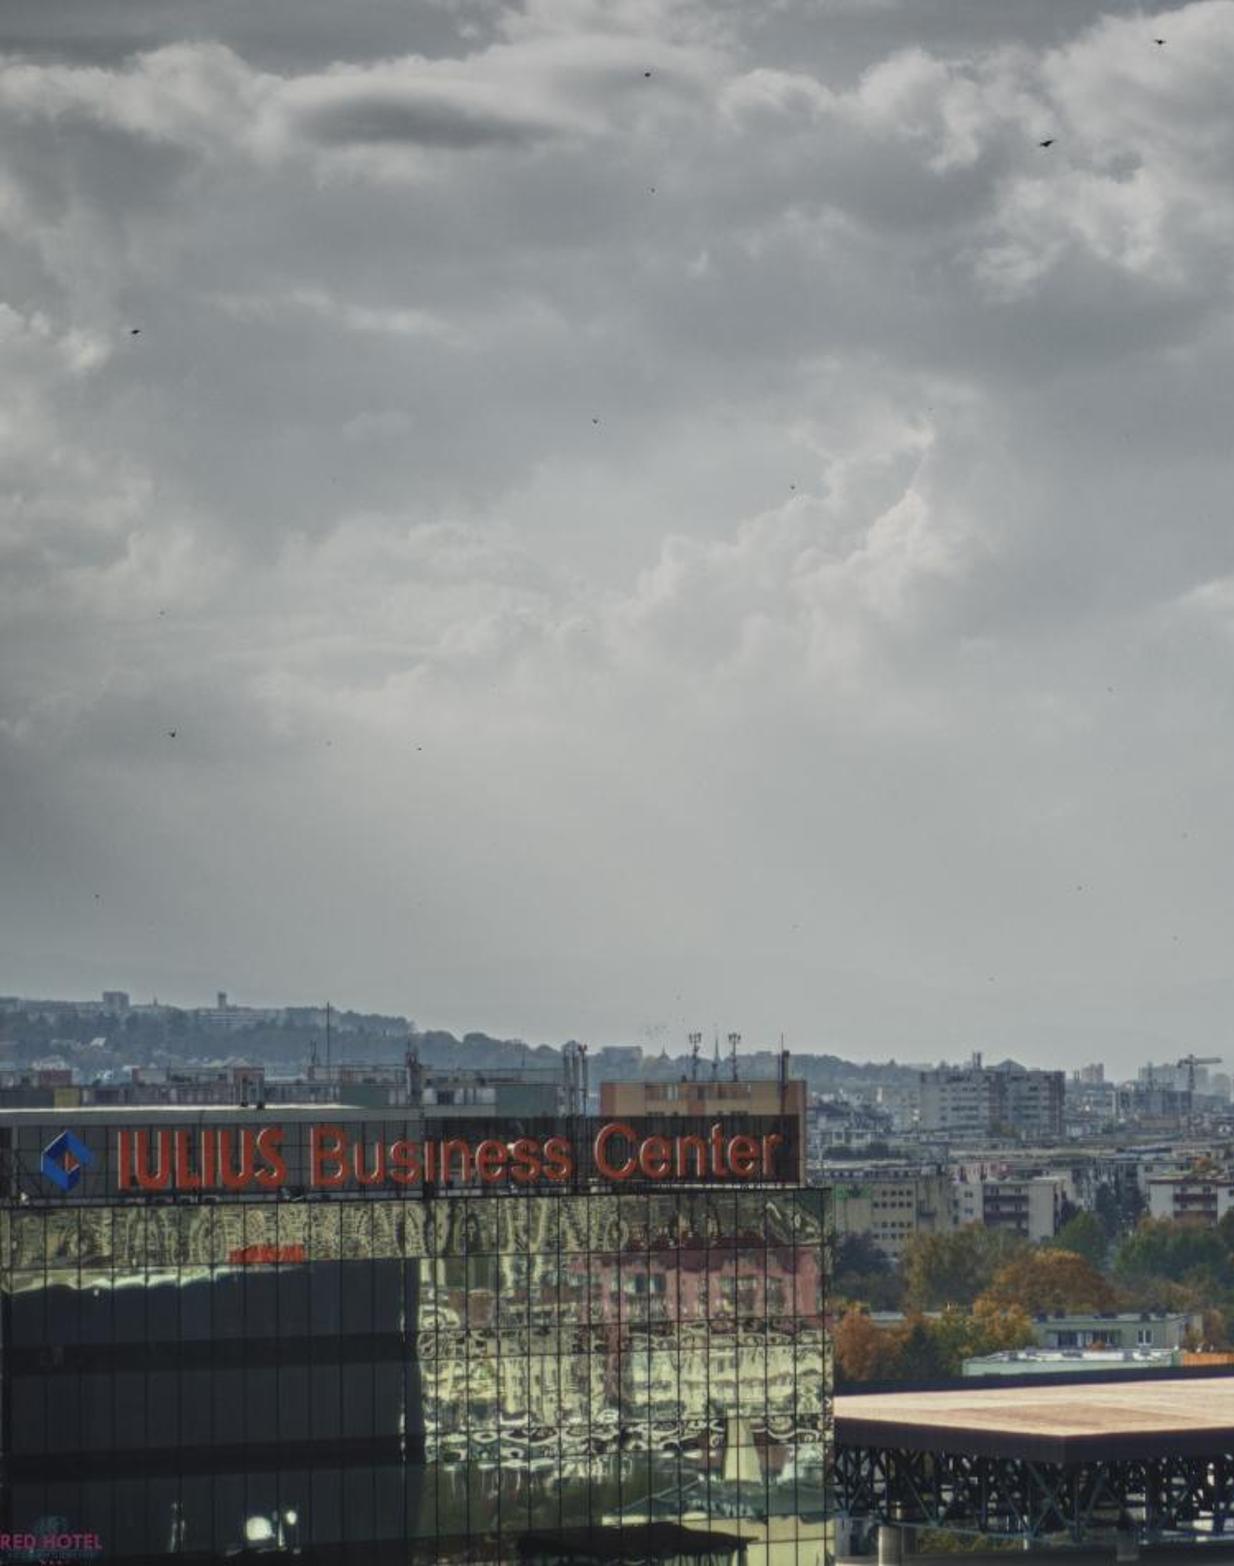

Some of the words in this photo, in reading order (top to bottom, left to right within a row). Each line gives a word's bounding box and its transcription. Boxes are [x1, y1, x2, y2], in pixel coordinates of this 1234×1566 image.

[116, 1127, 287, 1191] IULIUS
[309, 1124, 573, 1187] Business
[593, 1122, 784, 1181] Center
[0, 1534, 36, 1549] RED
[42, 1533, 103, 1550] HOTEL
